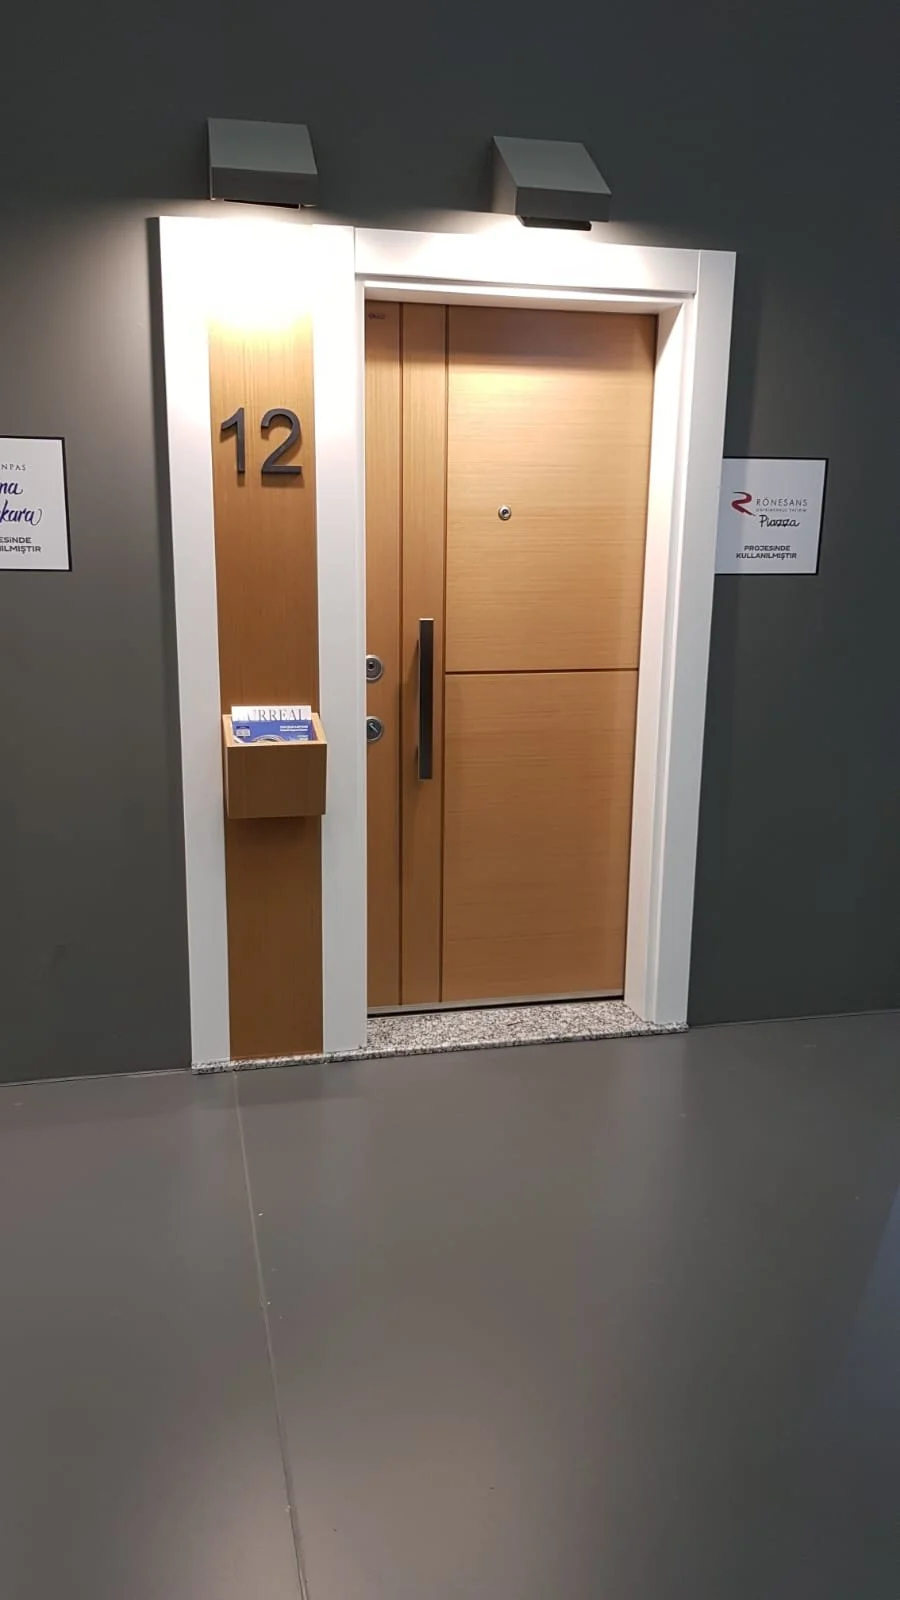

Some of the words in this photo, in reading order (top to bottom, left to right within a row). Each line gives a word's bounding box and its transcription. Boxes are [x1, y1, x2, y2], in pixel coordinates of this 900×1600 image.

[220, 407, 303, 474] 12
[0, 499, 42, 526] kara
[759, 514, 800, 528] Piazza
[0, 545, 41, 554] ILMIŞTIR
